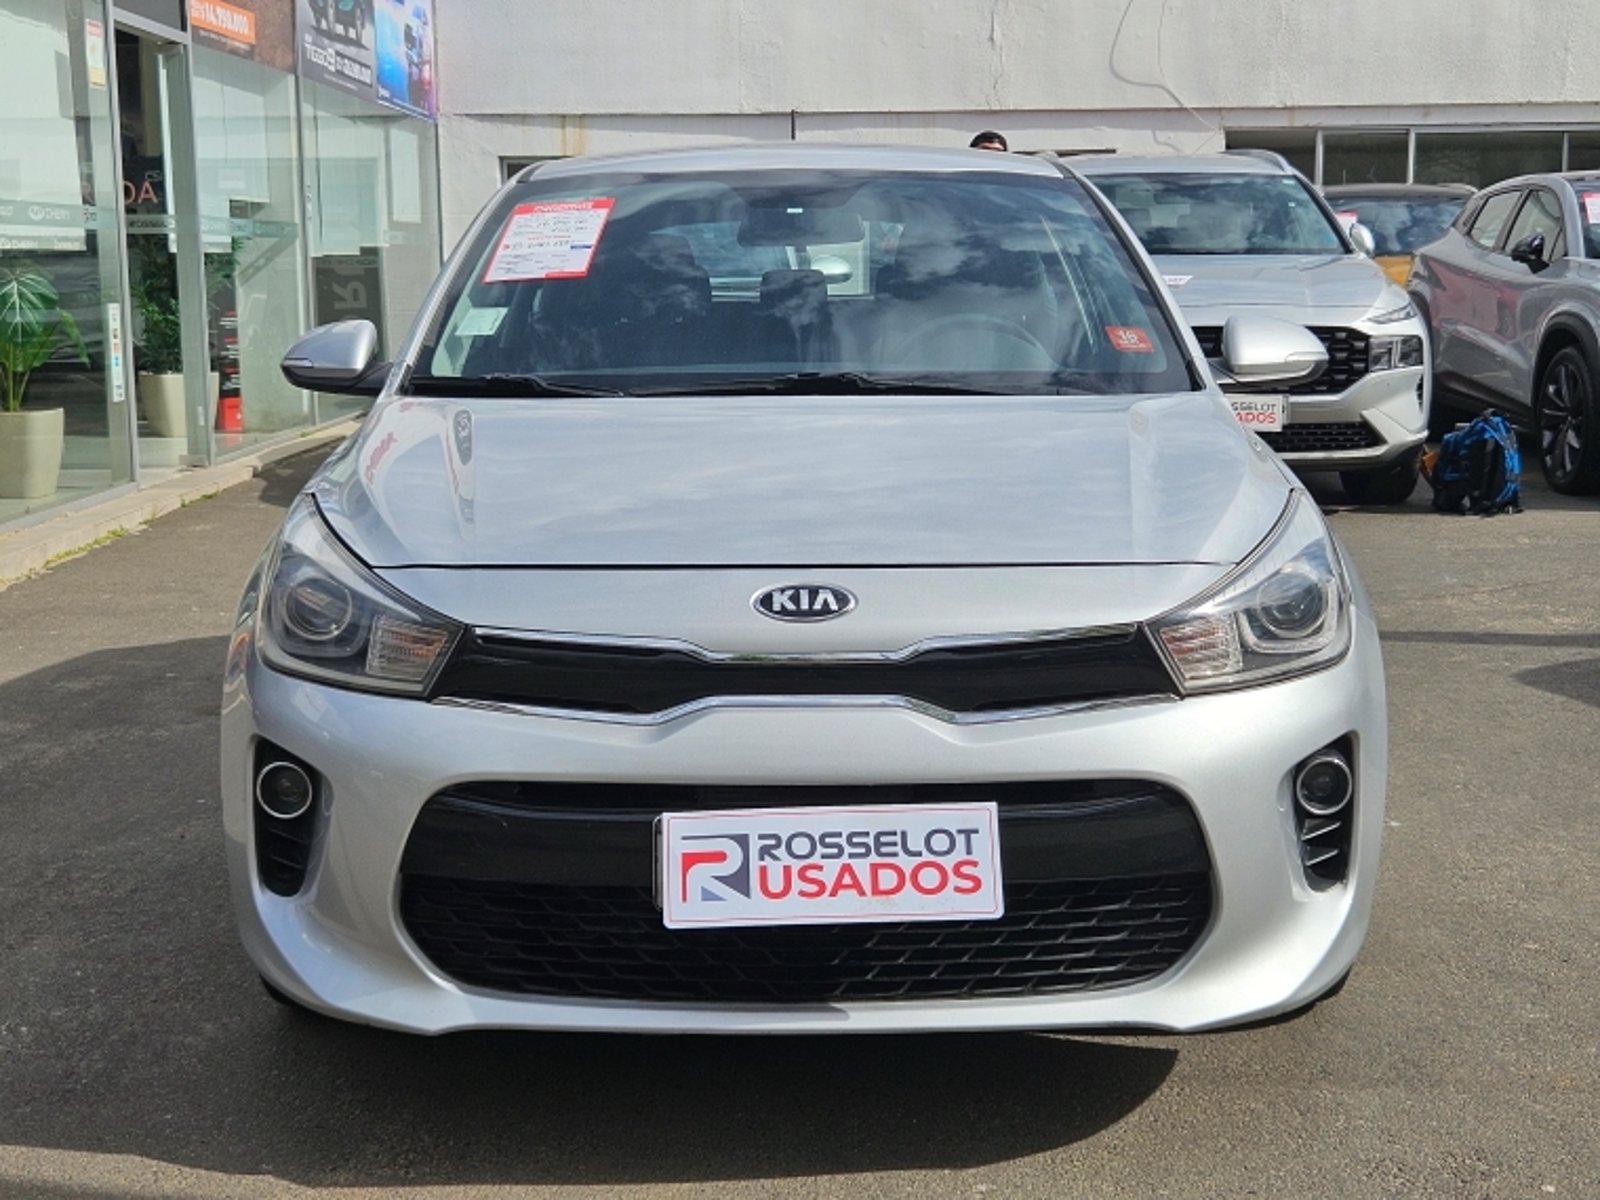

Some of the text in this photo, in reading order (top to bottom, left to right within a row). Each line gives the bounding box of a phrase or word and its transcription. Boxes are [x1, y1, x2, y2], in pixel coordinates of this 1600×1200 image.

[770, 588, 839, 612] KIA
[757, 828, 980, 862] ROSSELOT
[758, 860, 983, 900] USADOS
